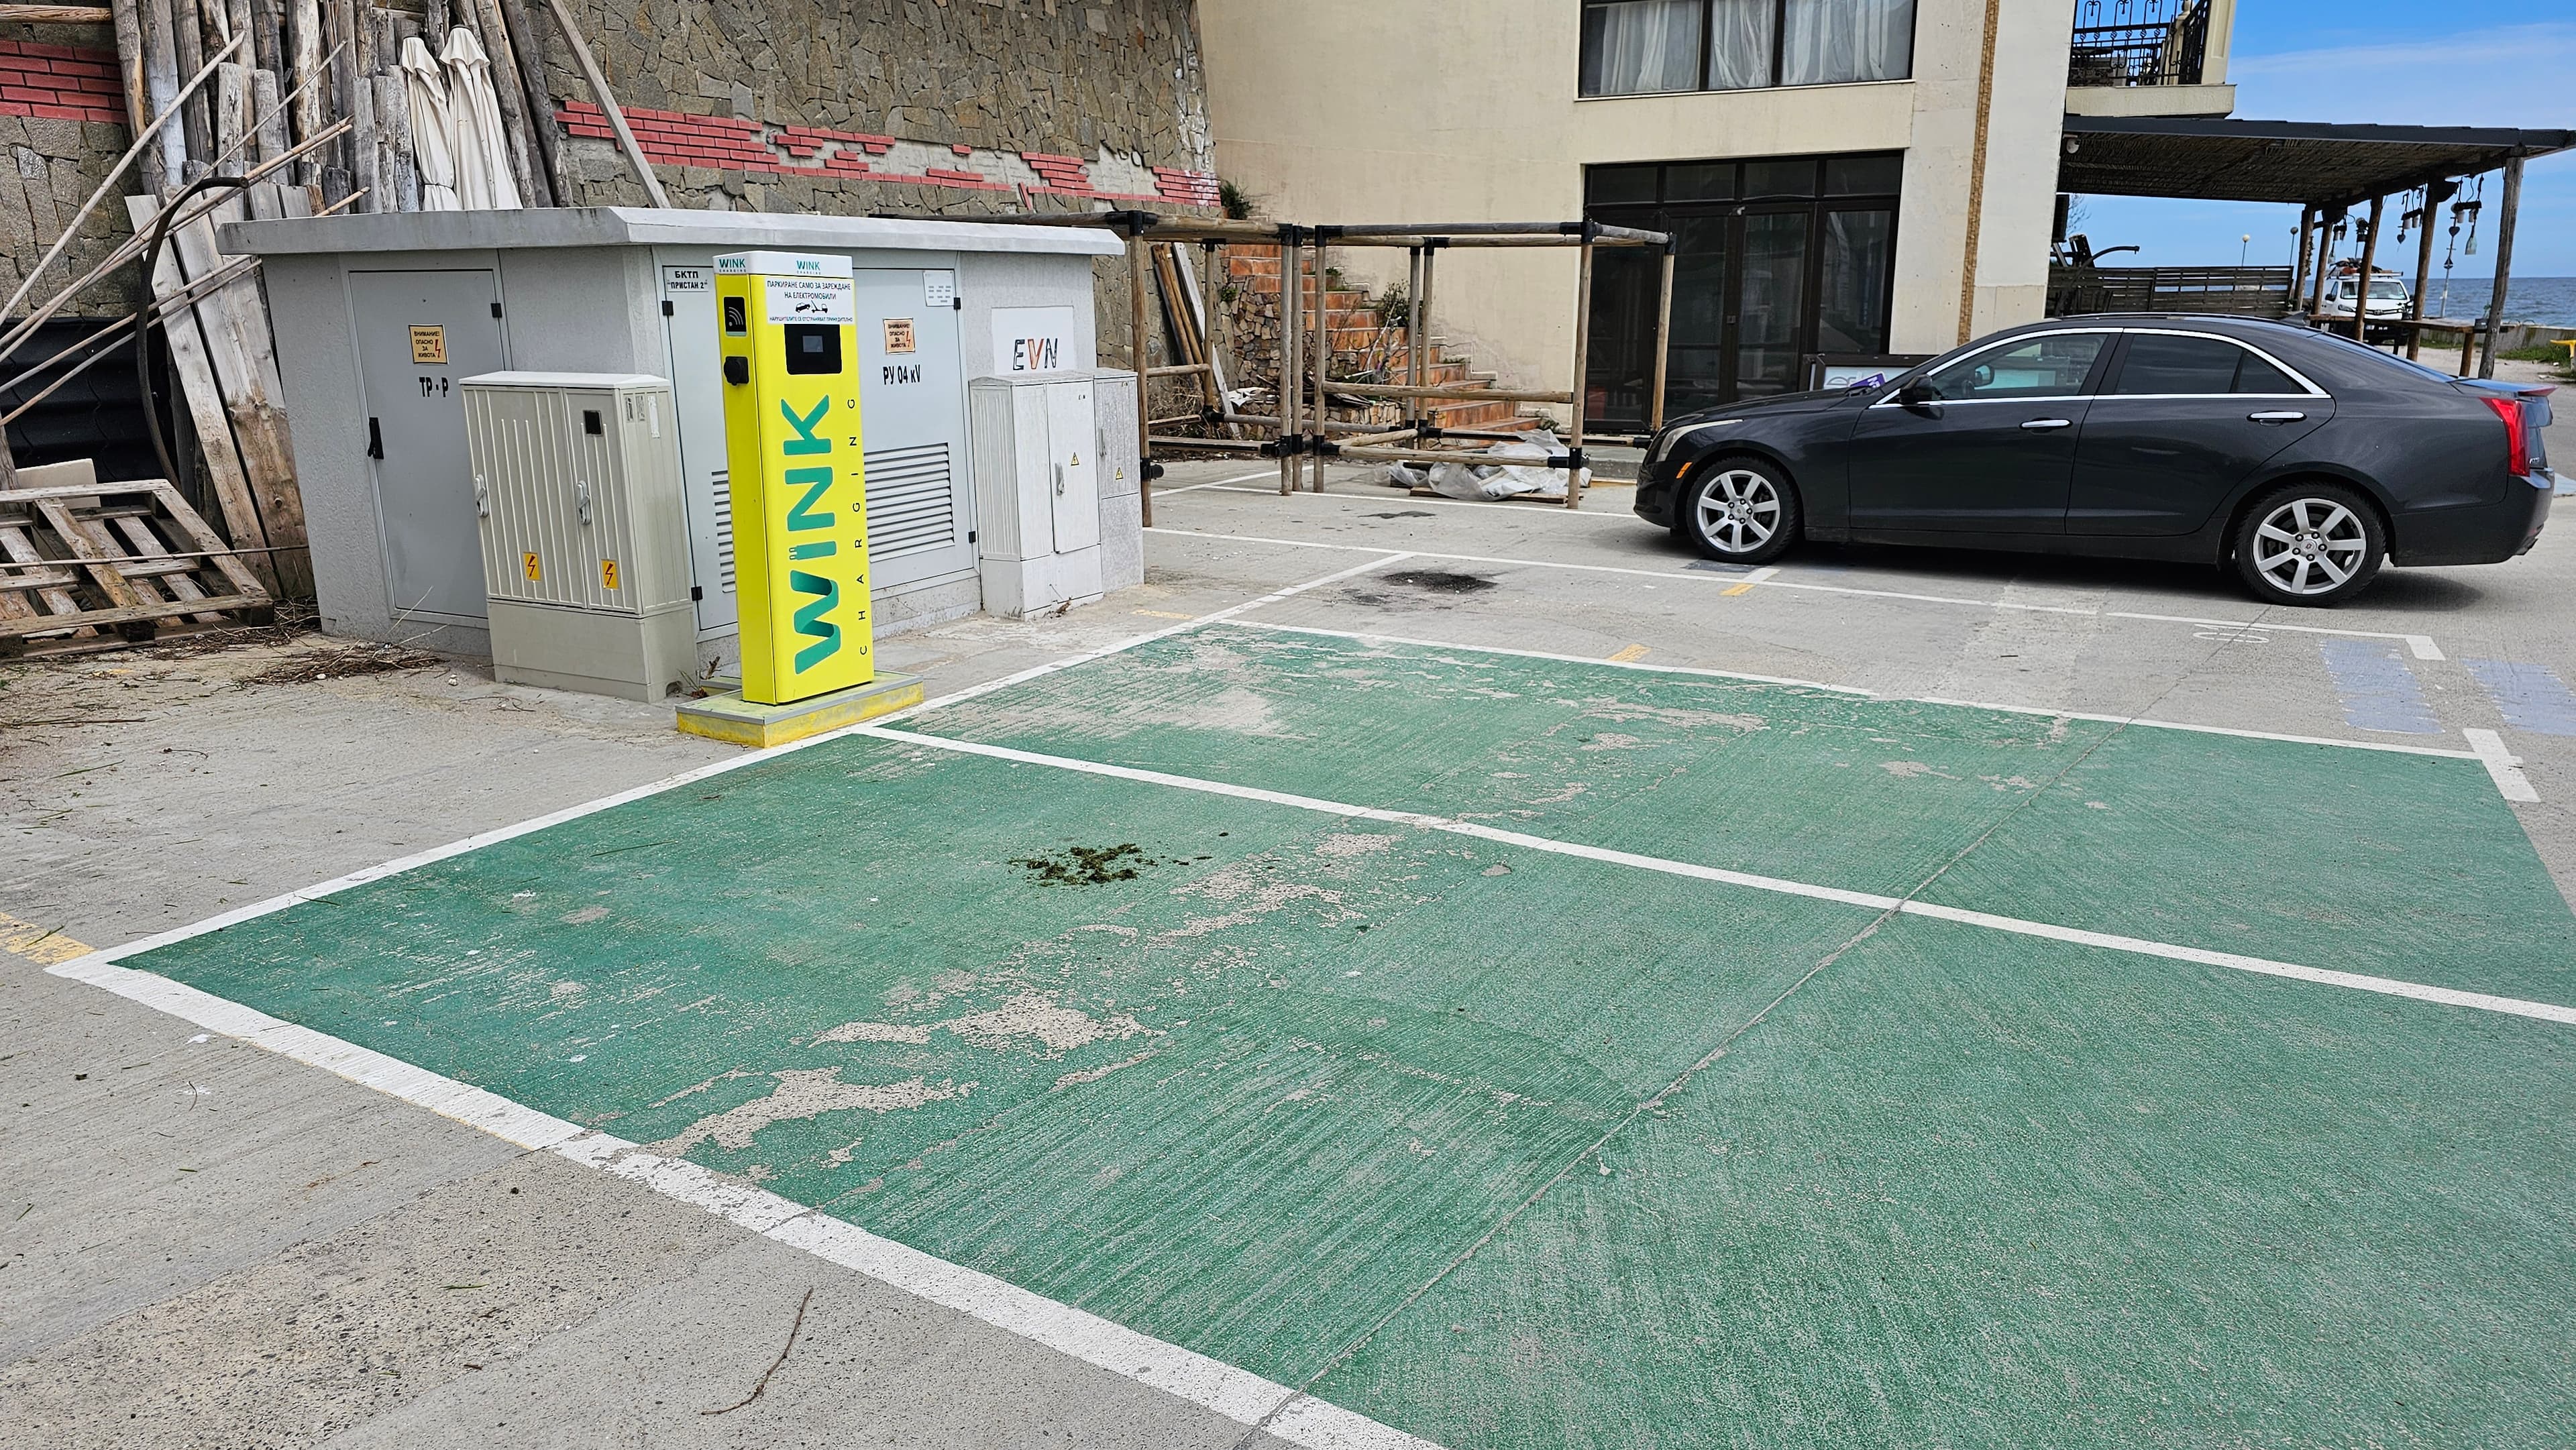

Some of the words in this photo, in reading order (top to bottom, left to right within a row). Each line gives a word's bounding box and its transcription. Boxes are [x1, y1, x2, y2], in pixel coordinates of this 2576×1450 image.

[719, 258, 745, 268] WINK
[796, 260, 820, 270] WINK
[675, 270, 699, 278] БКТП
[767, 280, 798, 288] ПАРКИРАНЕ
[1013, 338, 1058, 370] EVN
[898, 366, 908, 384] 04
[847, 398, 867, 655] CHARGING
[781, 394, 841, 675] WINK
